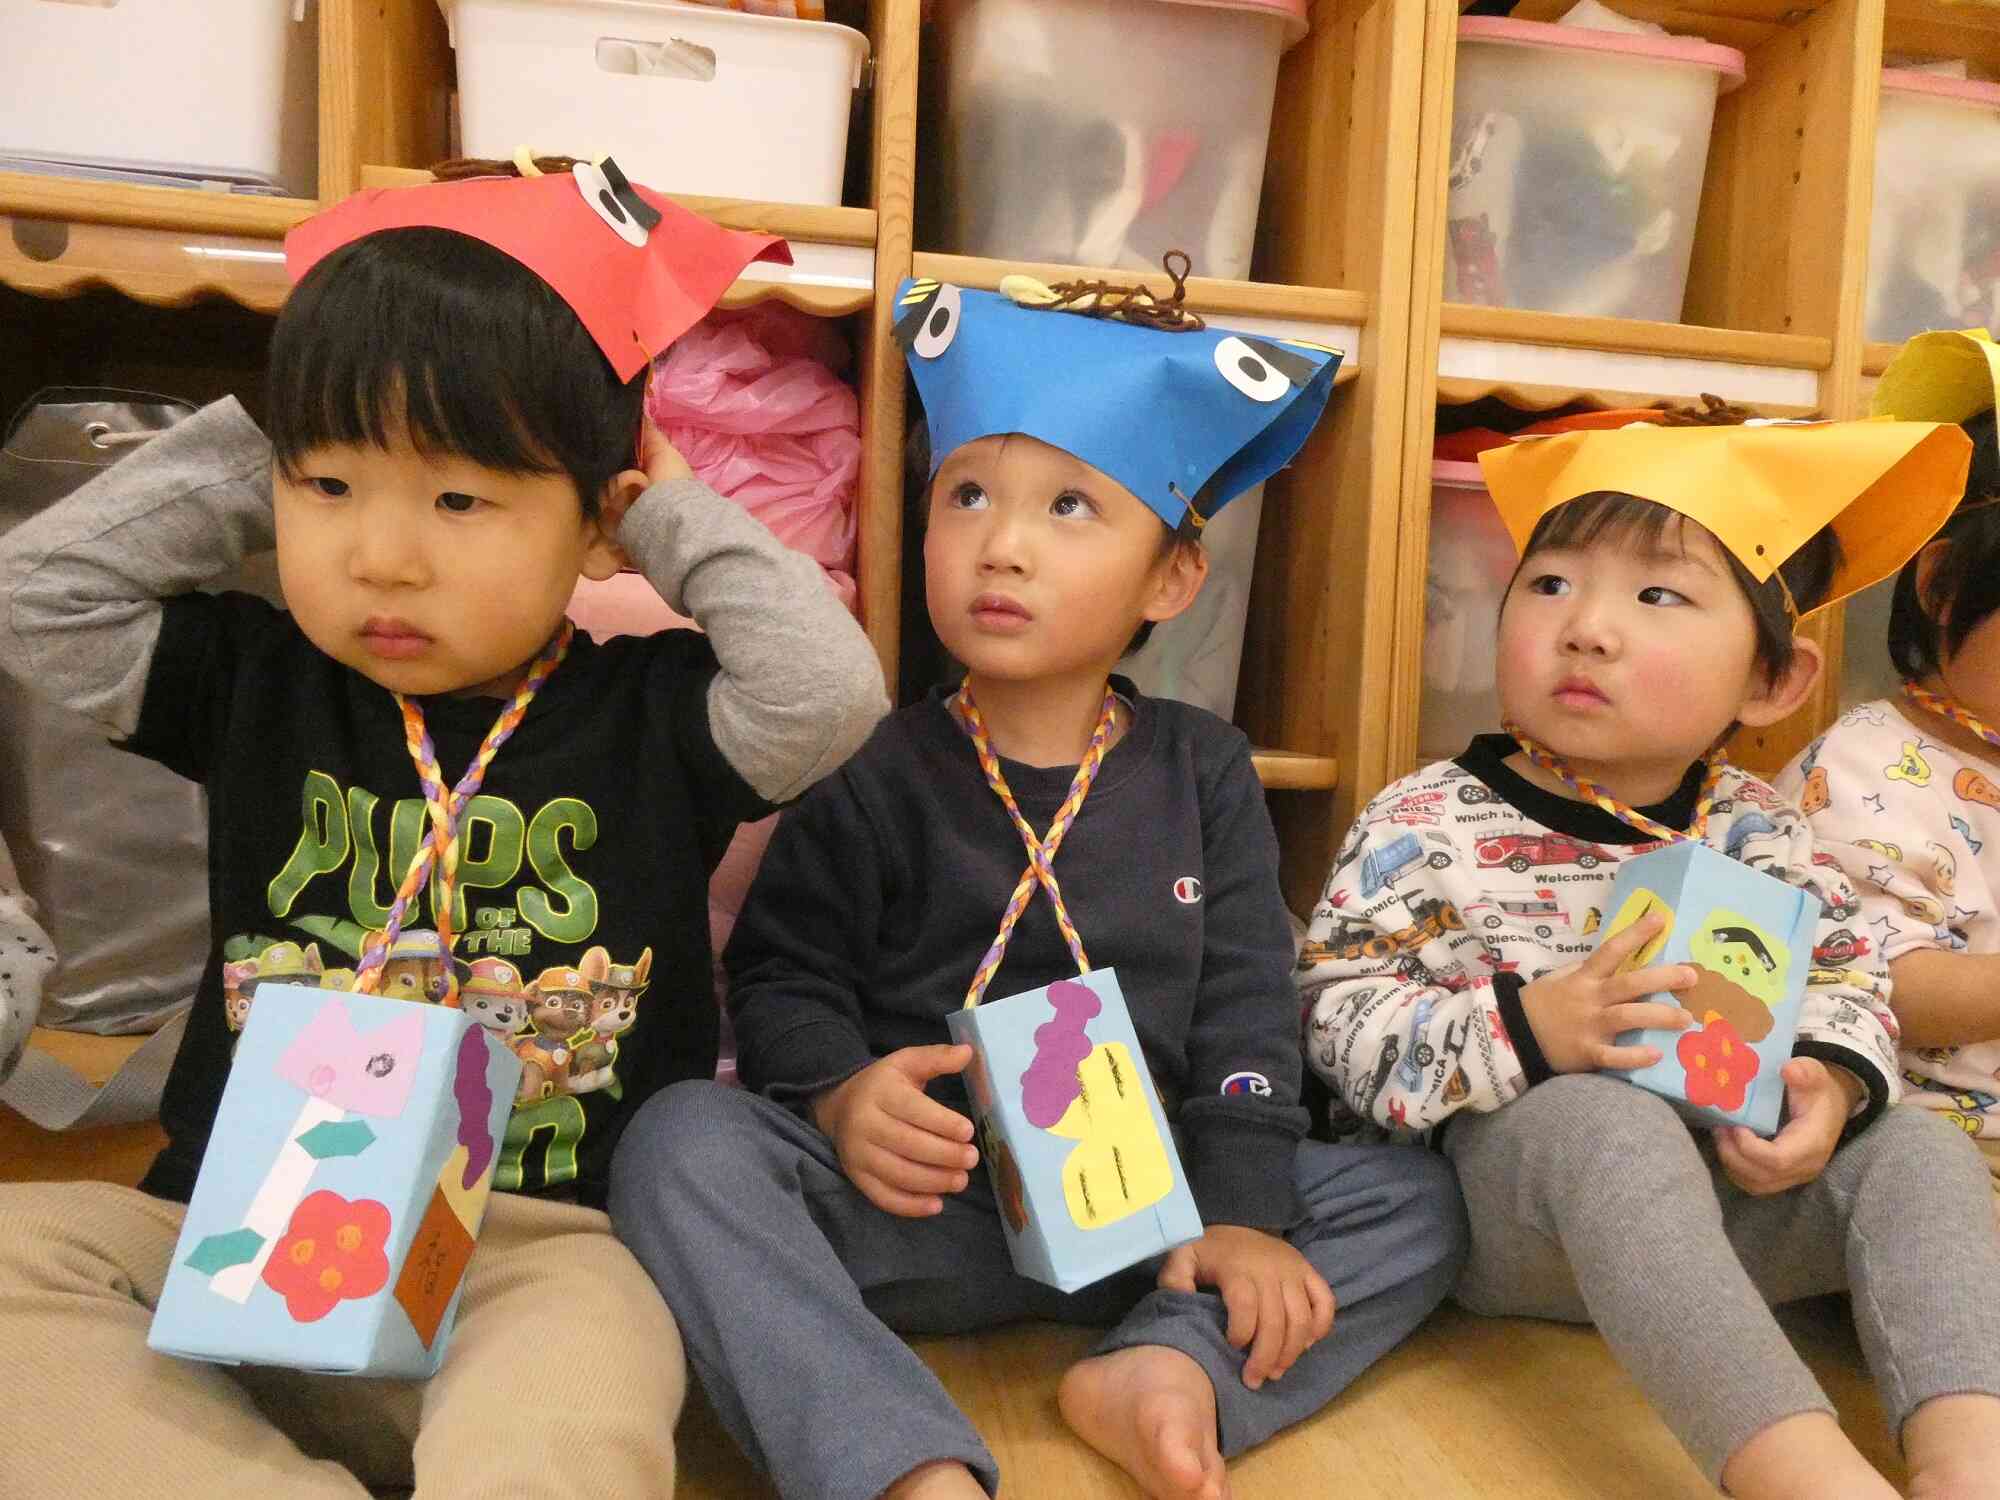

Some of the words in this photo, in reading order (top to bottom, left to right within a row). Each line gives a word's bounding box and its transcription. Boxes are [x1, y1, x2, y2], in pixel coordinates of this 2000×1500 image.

[1455, 810, 1497, 823] Which
[1502, 810, 1514, 819] is
[268, 769, 598, 943] PUPS
[1534, 872, 1604, 883] Welcome
[475, 906, 516, 929] OF
[463, 928, 532, 955] THE
[1341, 1019, 1365, 1063] Ending
[1362, 986, 1401, 1018] Dream
